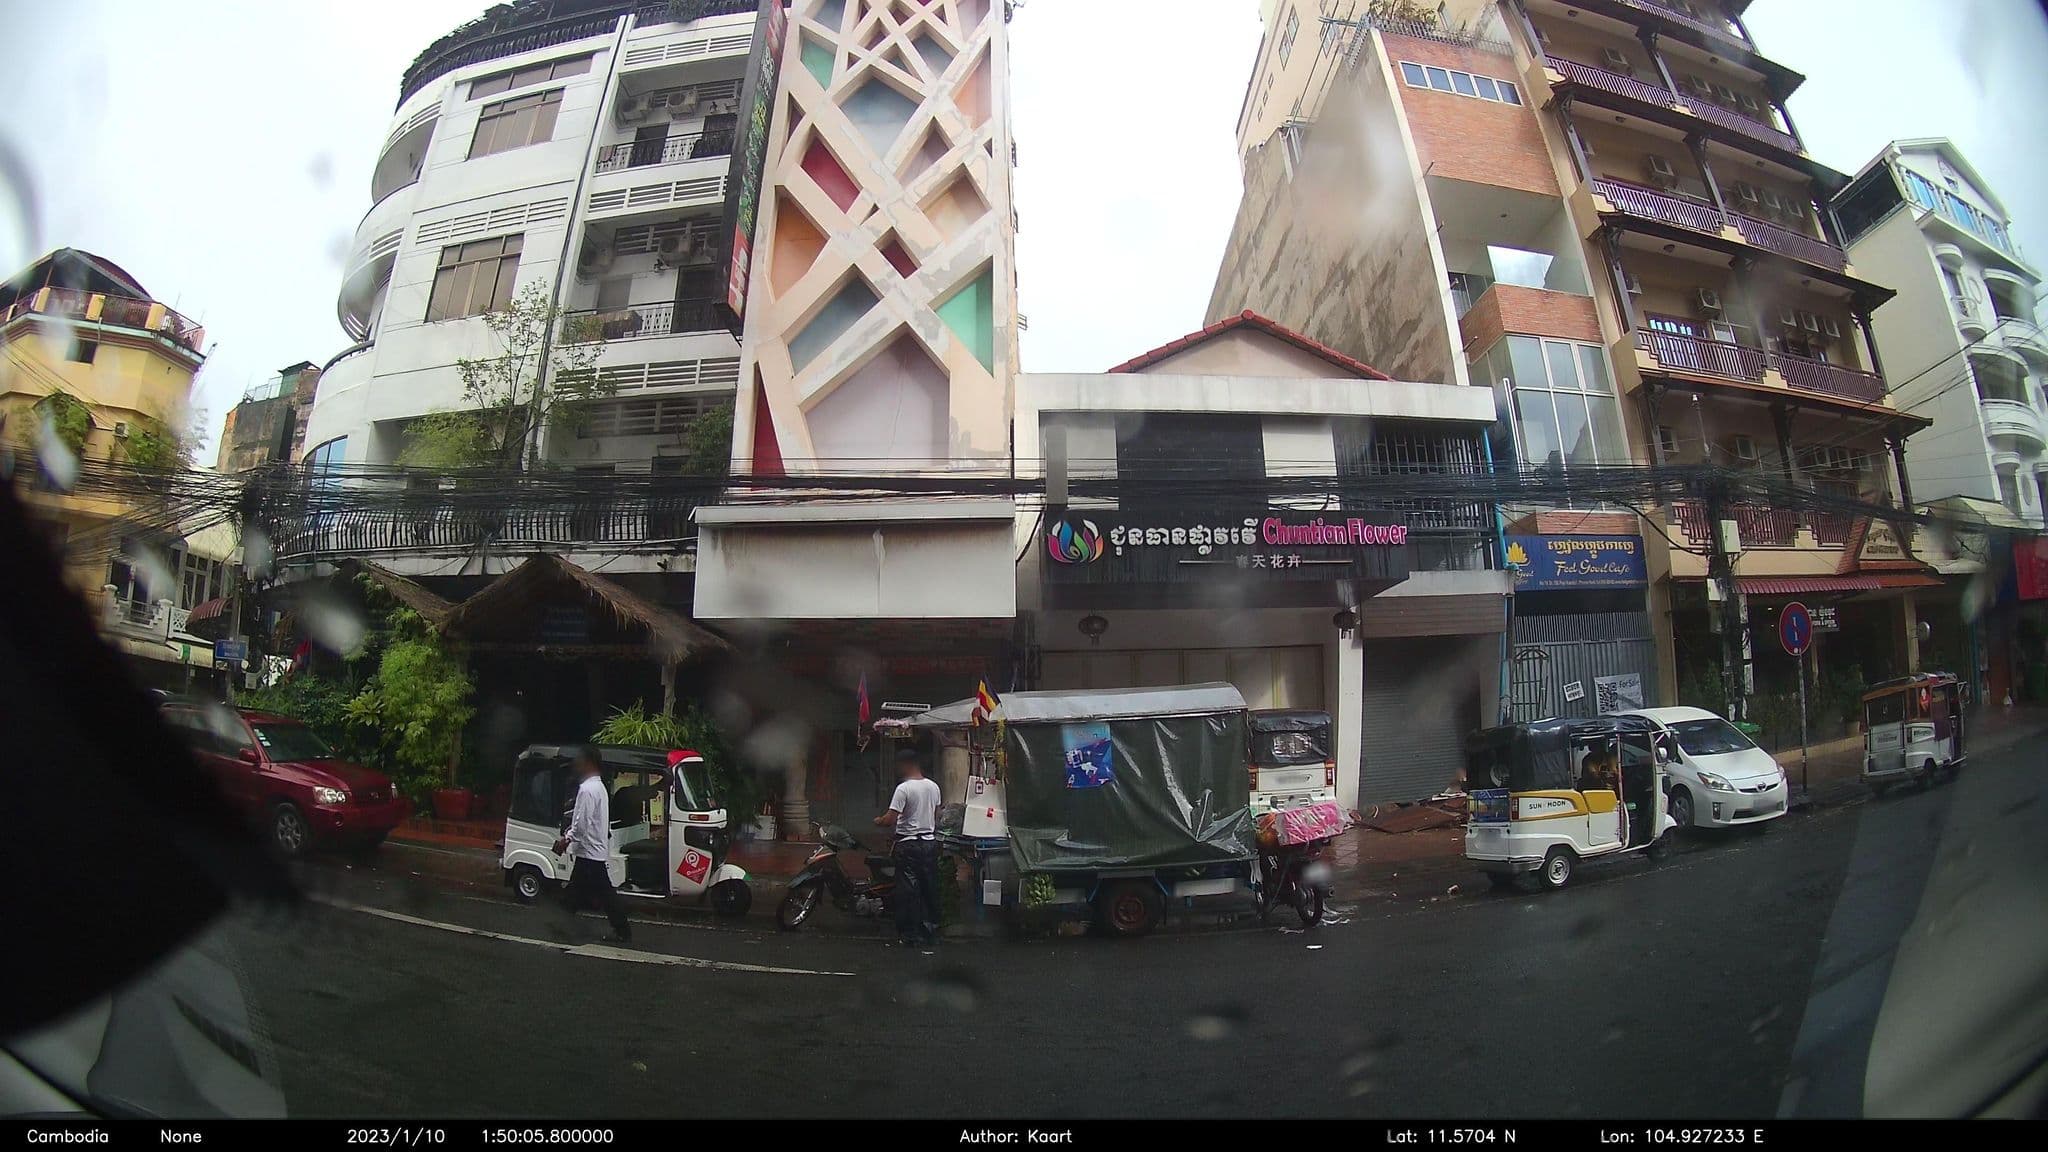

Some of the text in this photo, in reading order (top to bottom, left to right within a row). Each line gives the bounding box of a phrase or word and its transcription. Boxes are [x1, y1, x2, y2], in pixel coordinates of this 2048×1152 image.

[1263, 517, 1408, 545] Chuntian Flower
[1554, 560, 1577, 577] Feel
[1579, 559, 1608, 575] Good
[1528, 800, 1566, 810] SUN MOON
